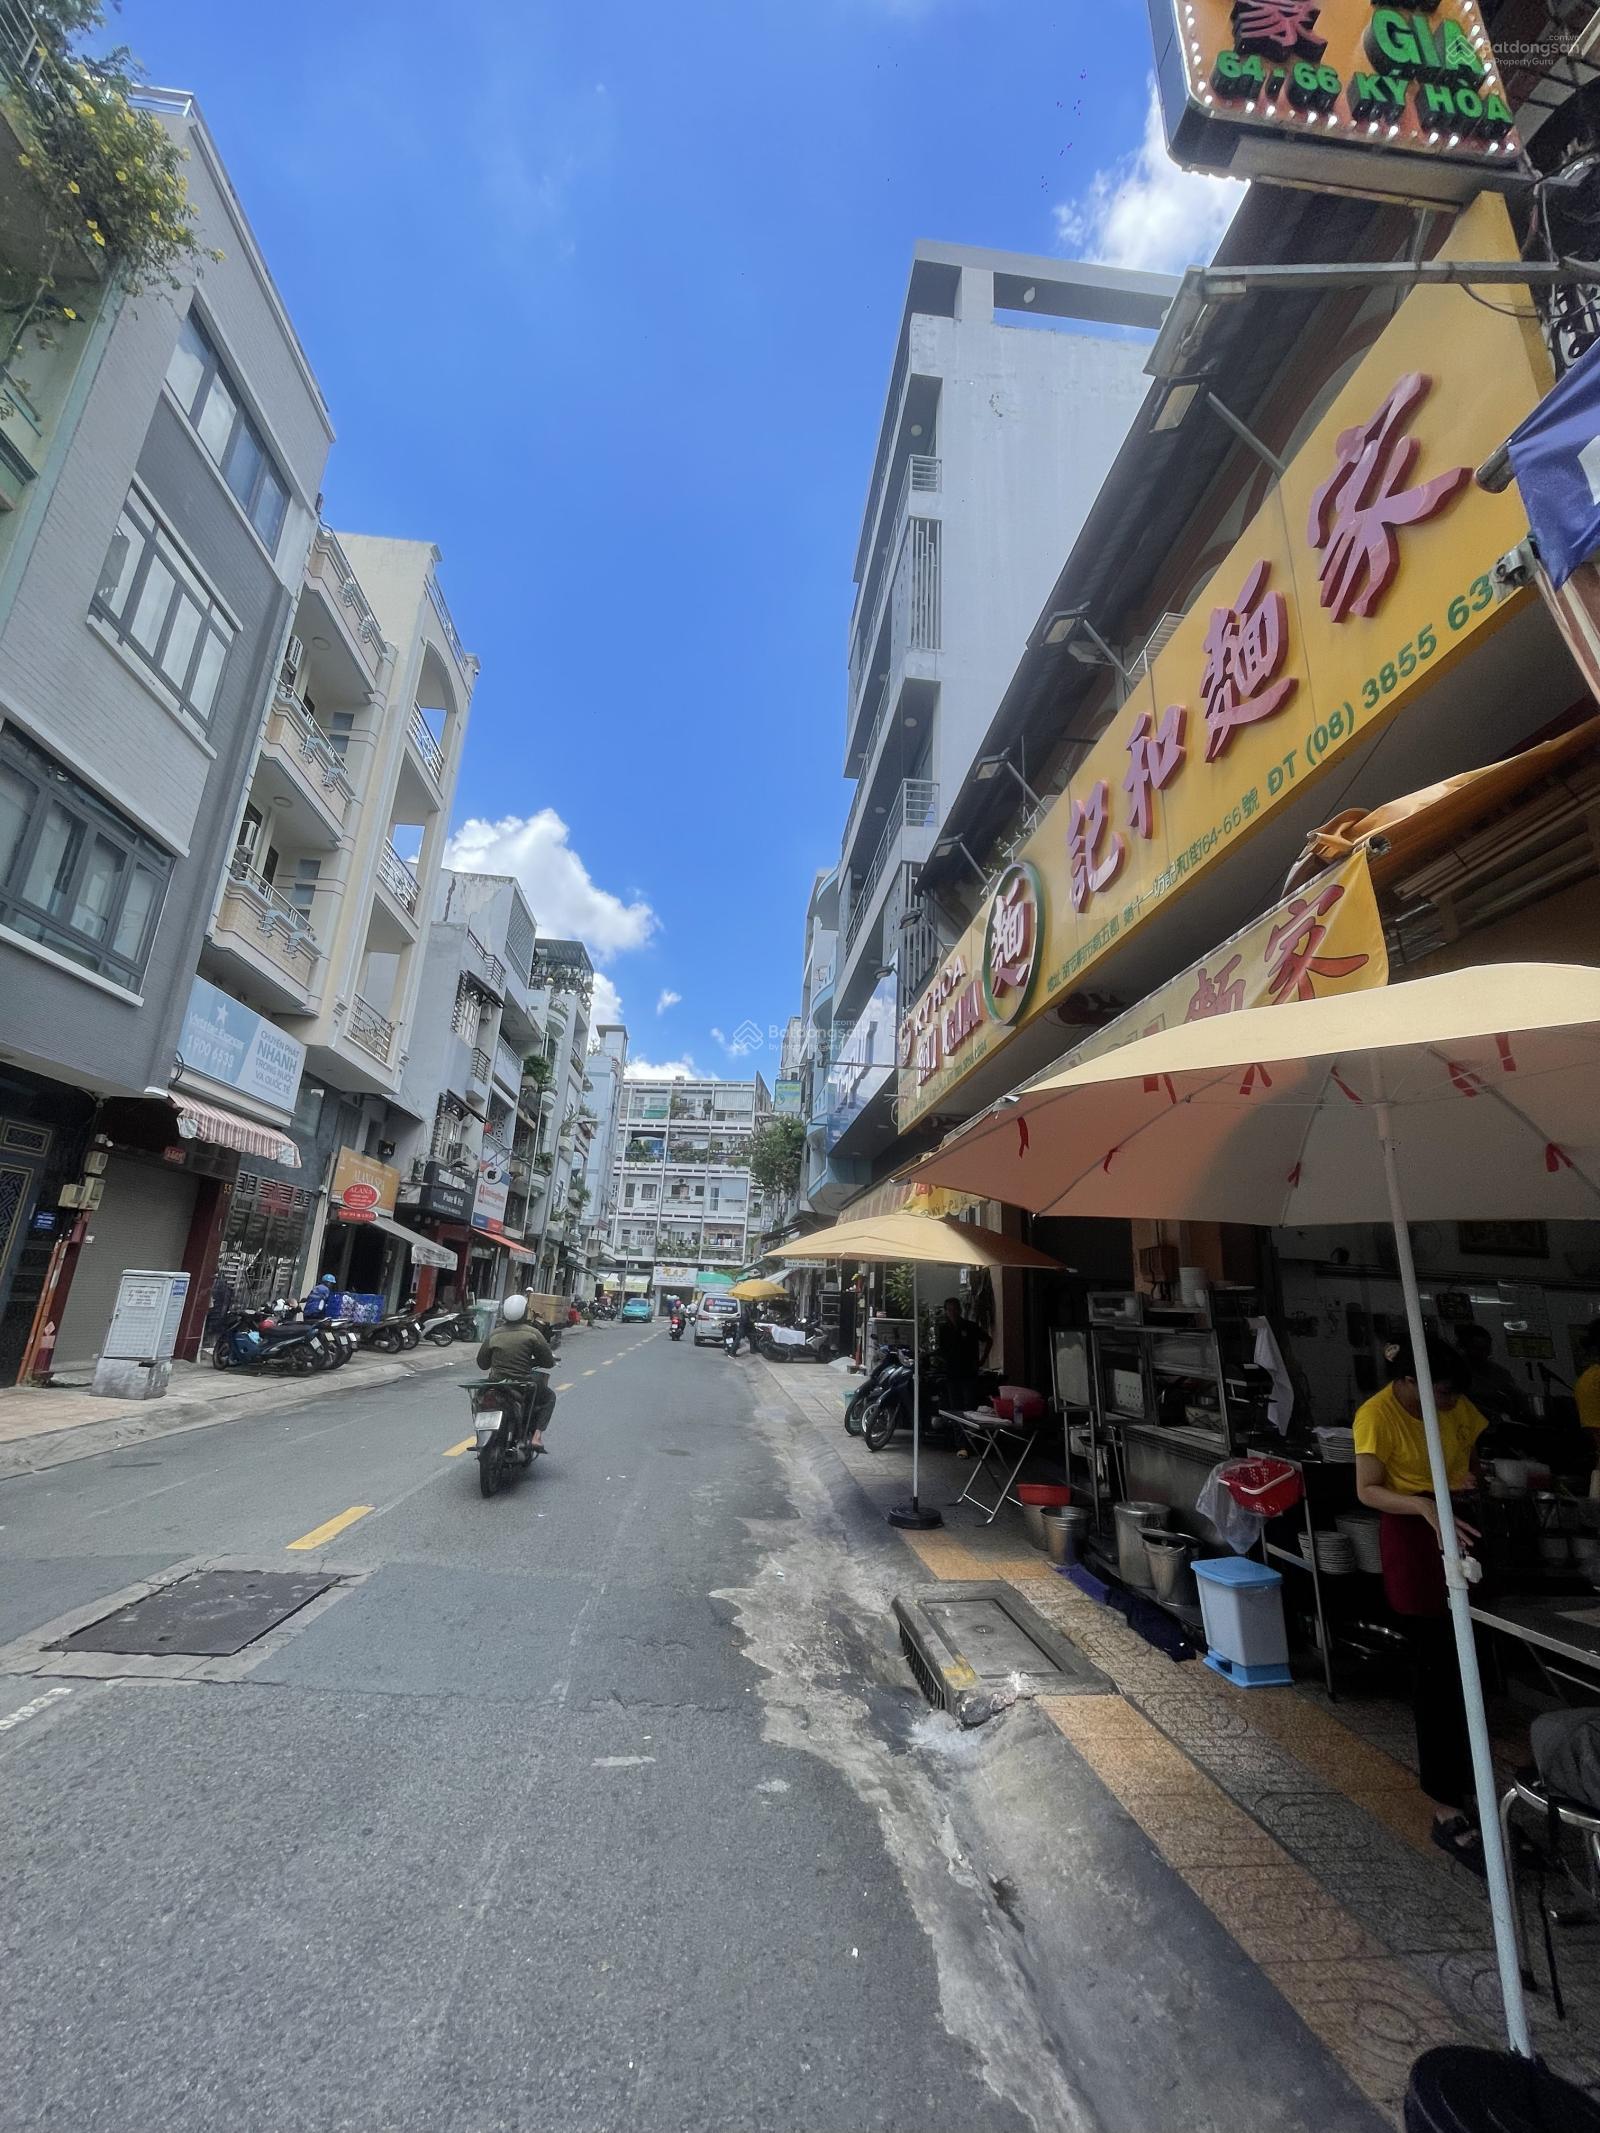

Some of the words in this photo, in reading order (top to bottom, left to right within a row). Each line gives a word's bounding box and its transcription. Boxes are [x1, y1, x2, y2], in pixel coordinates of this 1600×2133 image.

[1371, 8, 1486, 77] GIA
[1217, 50, 1266, 82] 64
[1293, 61, 1342, 95] 66
[1354, 68, 1409, 106] KÝ
[1423, 78, 1515, 124] HÒA
[1266, 749, 1298, 797] ĐT
[1305, 701, 1355, 766] (08)
[1361, 623, 1438, 710] 3855
[1446, 574, 1498, 632] 63
[256, 1040, 298, 1074] NHANH
